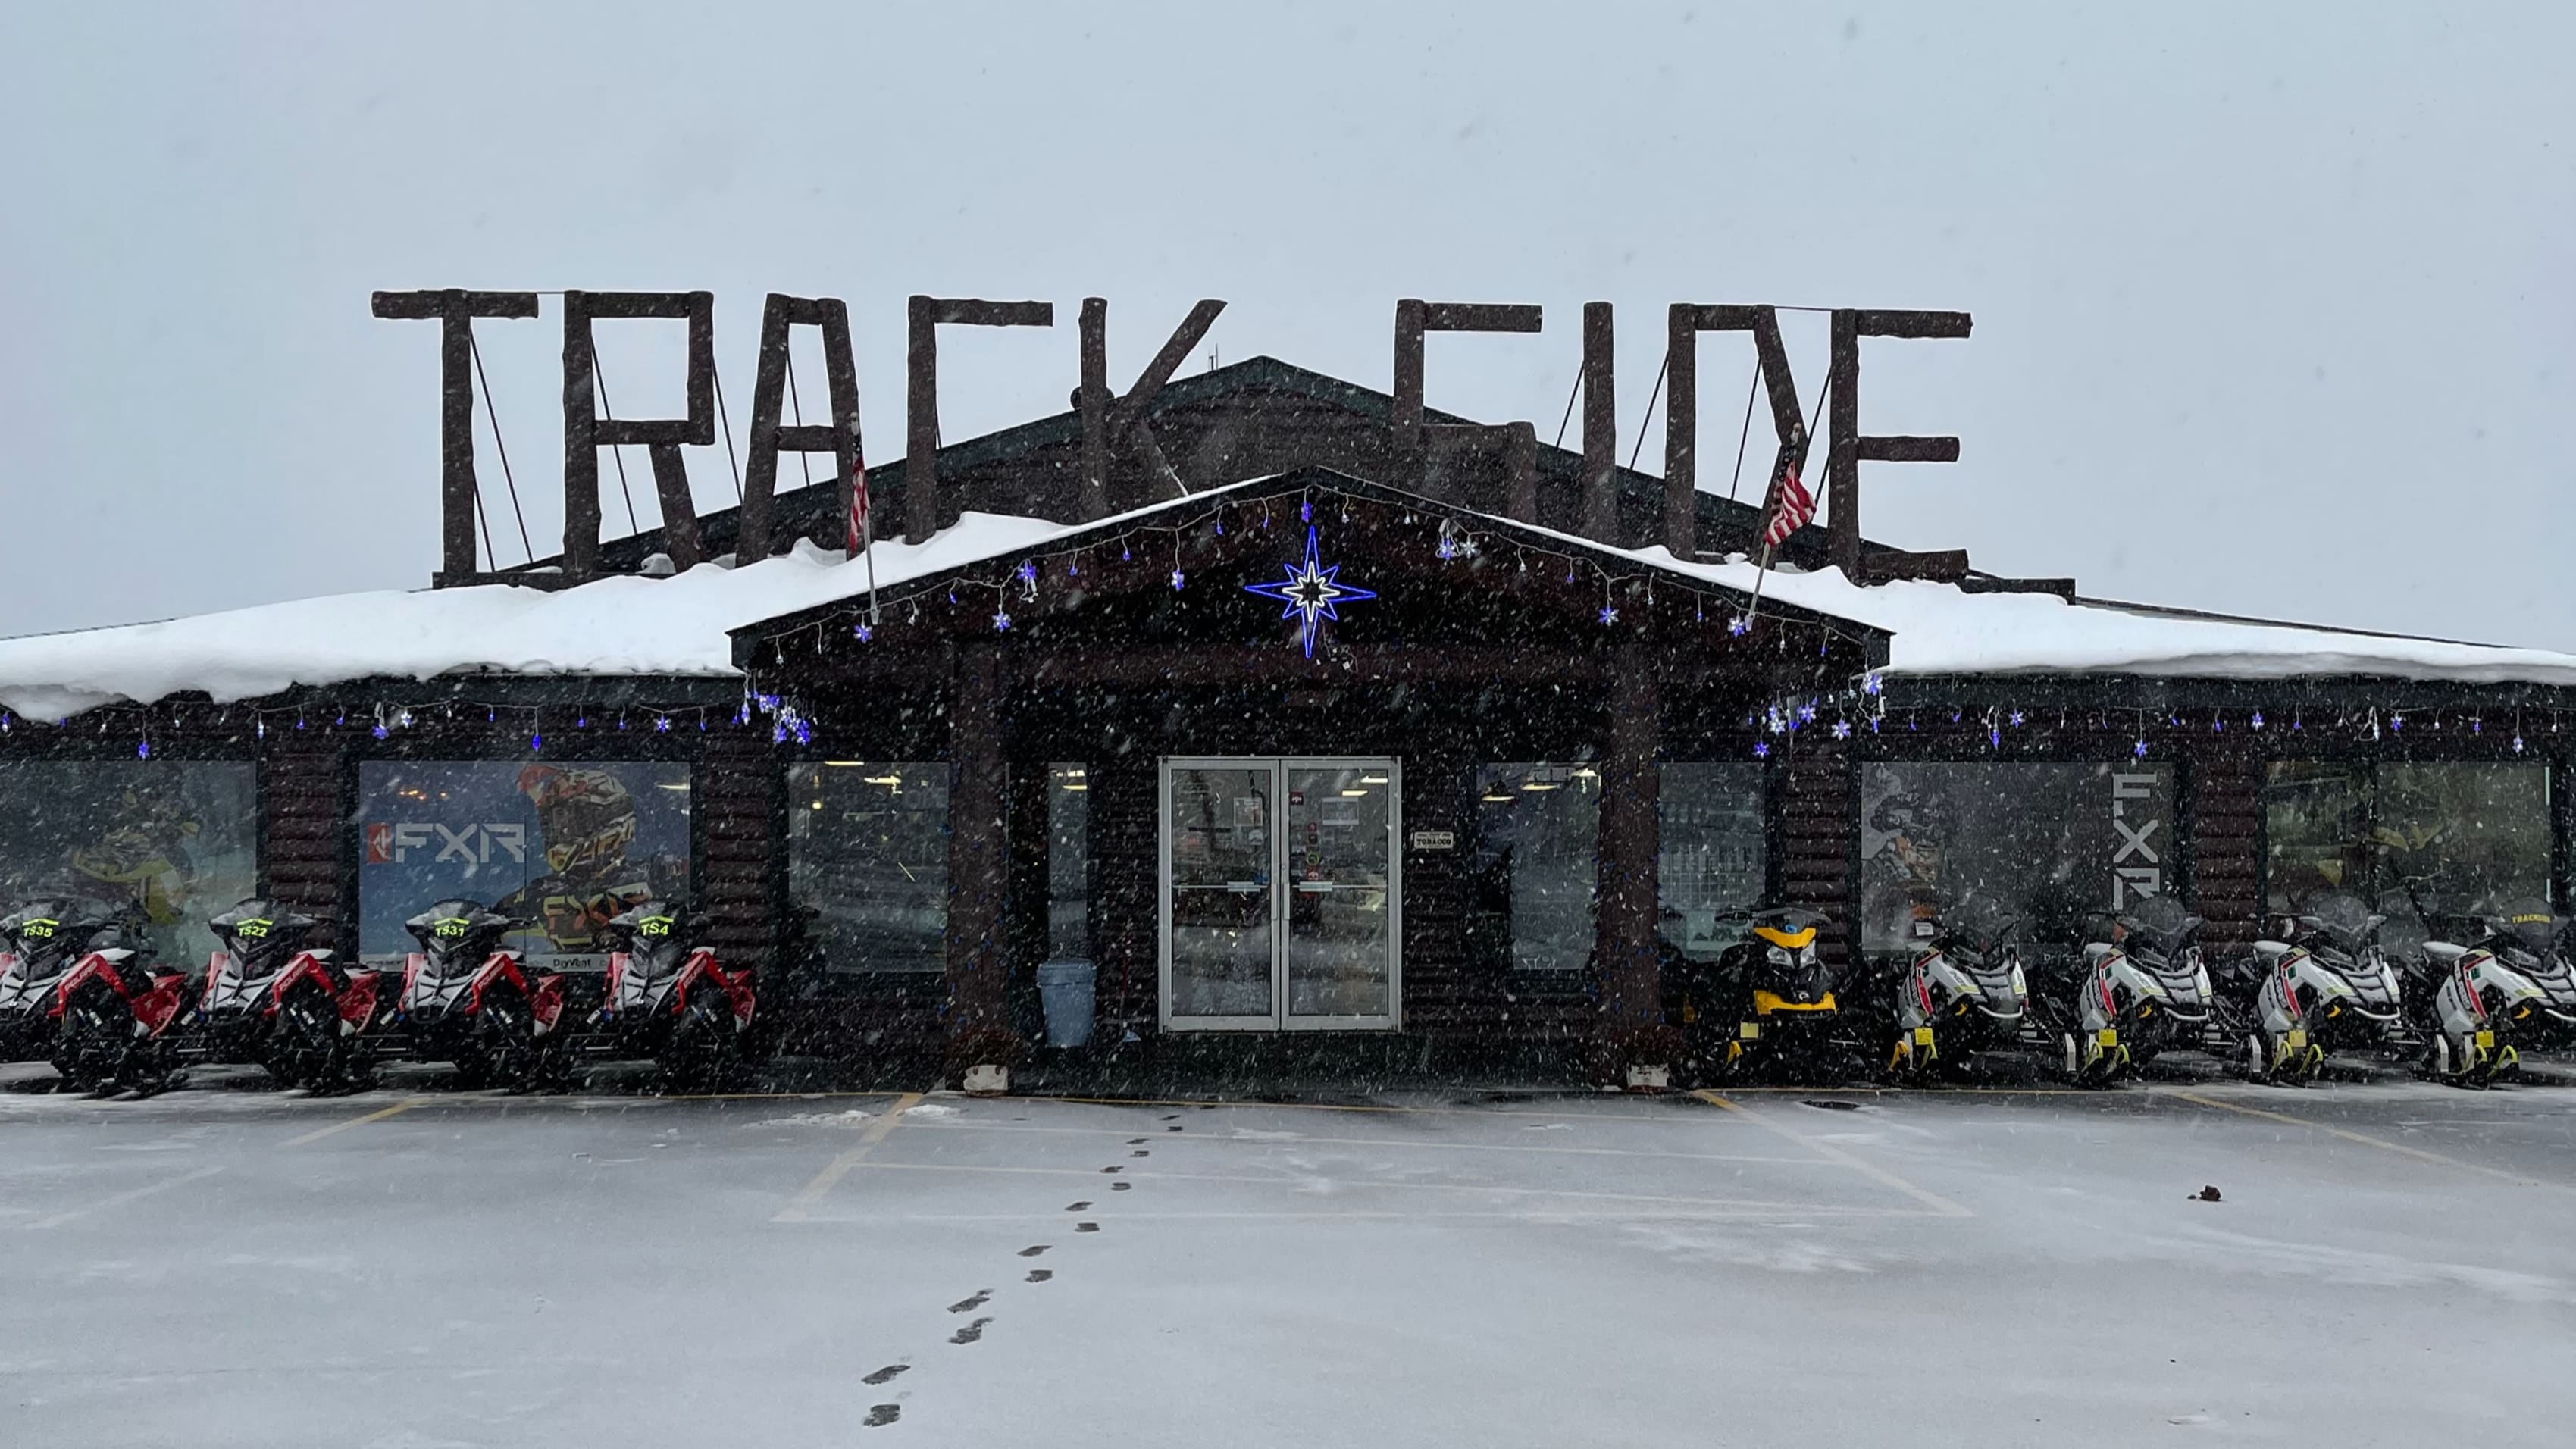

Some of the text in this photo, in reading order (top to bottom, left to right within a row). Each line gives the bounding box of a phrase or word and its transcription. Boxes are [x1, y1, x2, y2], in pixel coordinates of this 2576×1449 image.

[371, 289, 1973, 585] TRACK SIDE
[396, 823, 524, 862] FXR
[2113, 773, 2160, 910] FXR
[23, 926, 52, 937] TS35
[239, 927, 267, 937] TS22
[435, 927, 465, 937] TS31
[641, 922, 668, 936] TS4
